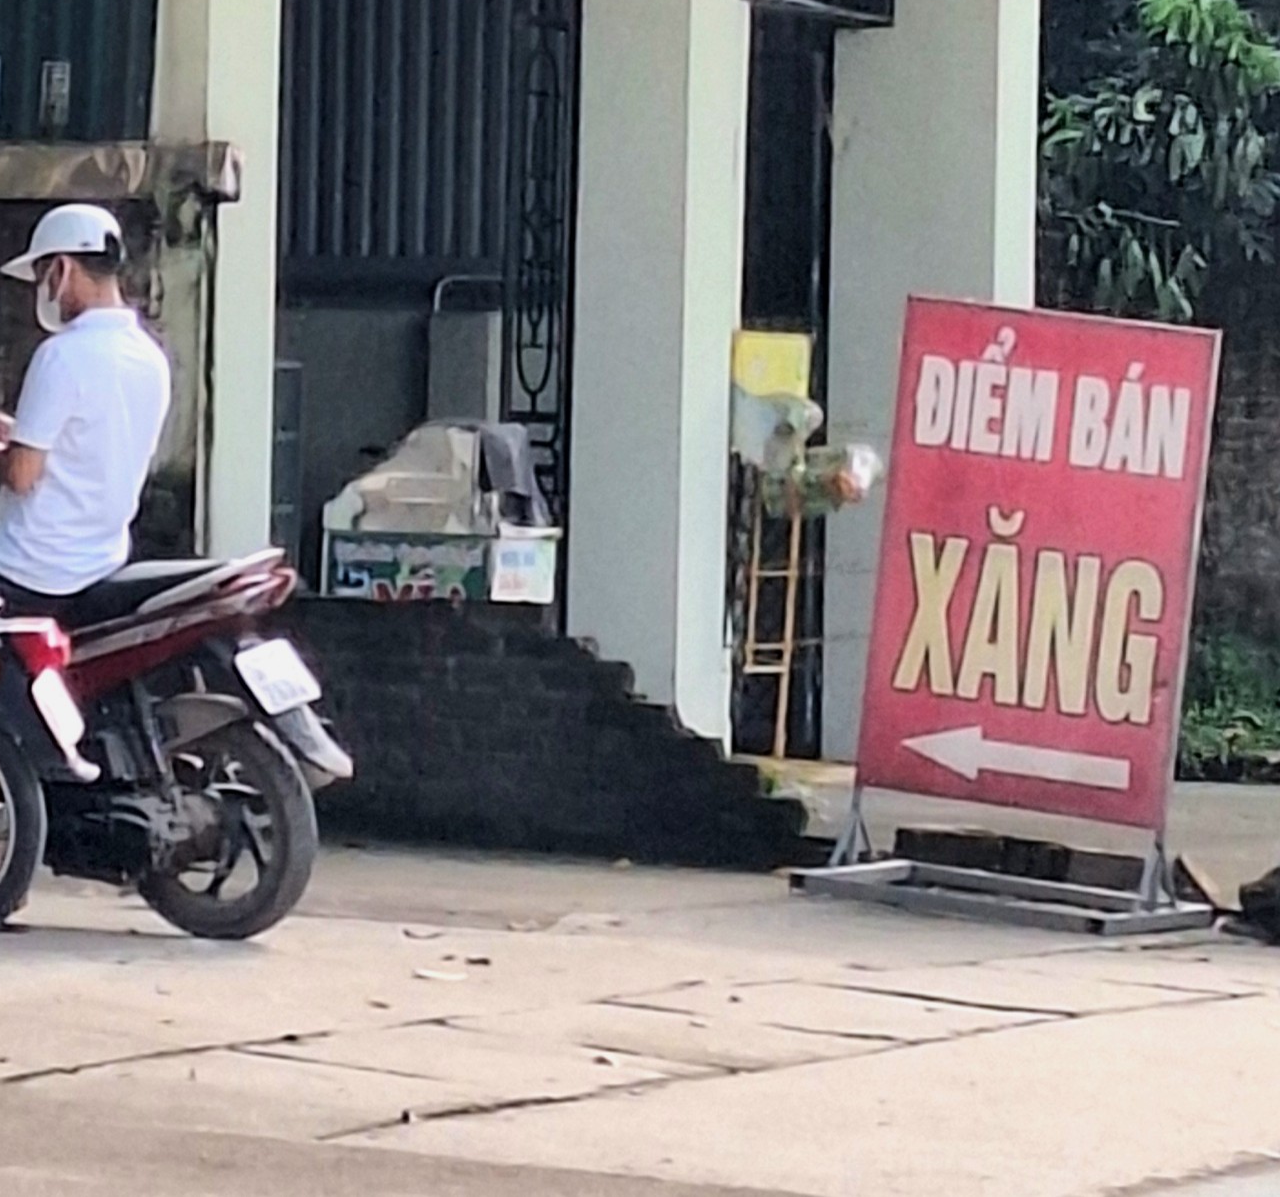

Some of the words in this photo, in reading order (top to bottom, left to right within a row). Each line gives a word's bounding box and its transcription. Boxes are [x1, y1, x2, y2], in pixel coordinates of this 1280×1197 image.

[914, 327, 1059, 462] ĐIỂM
[1069, 362, 1191, 480] BÁN
[892, 506, 1165, 725] XĂNG
